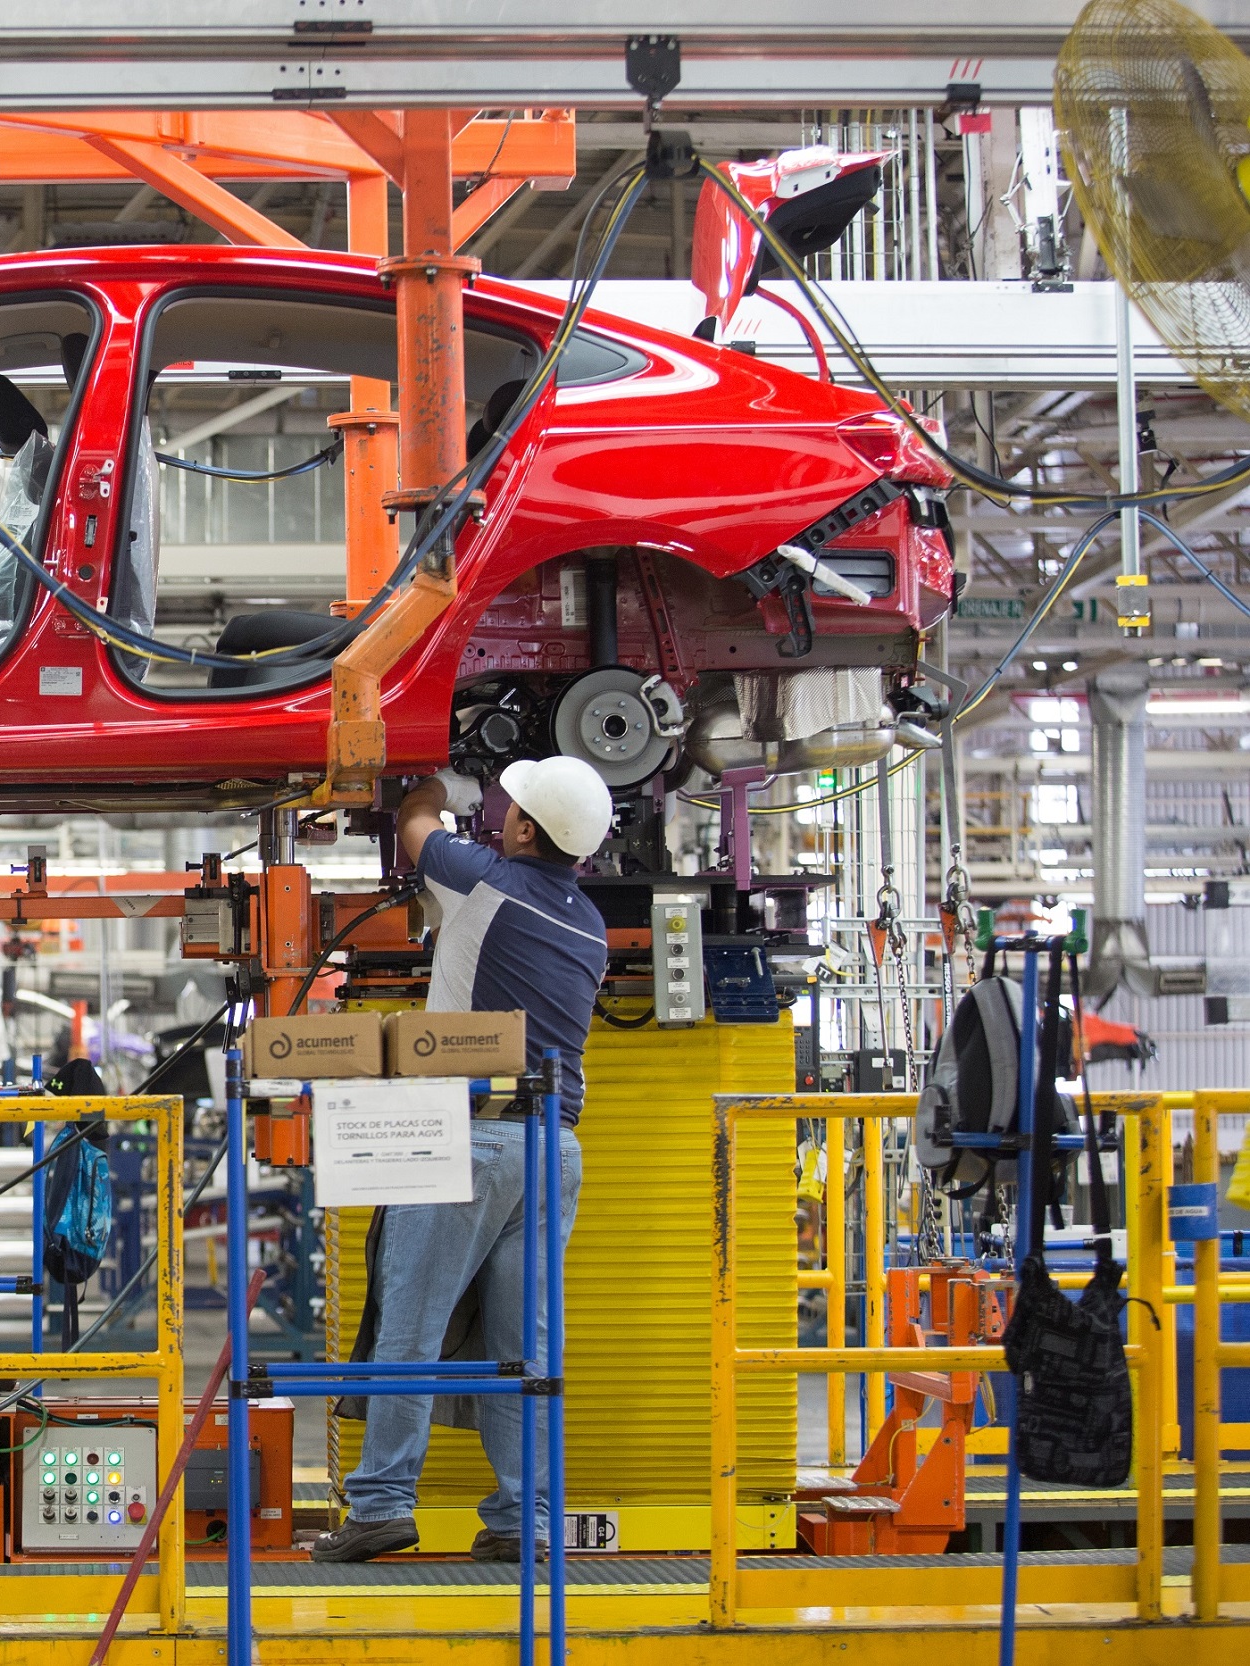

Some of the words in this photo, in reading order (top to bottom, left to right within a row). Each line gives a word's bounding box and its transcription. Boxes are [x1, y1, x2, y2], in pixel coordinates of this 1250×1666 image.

[297, 1034, 355, 1048] acument
[441, 1033, 499, 1046] acument
[336, 1121, 367, 1130] STOCK
[369, 1121, 381, 1129] DE
[384, 1120, 420, 1128] PLACAS
[421, 1119, 443, 1127] CON
[337, 1131, 388, 1140] TORNILLOS
[391, 1130, 415, 1138] PARA
[598, 1526, 605, 1537] G4
